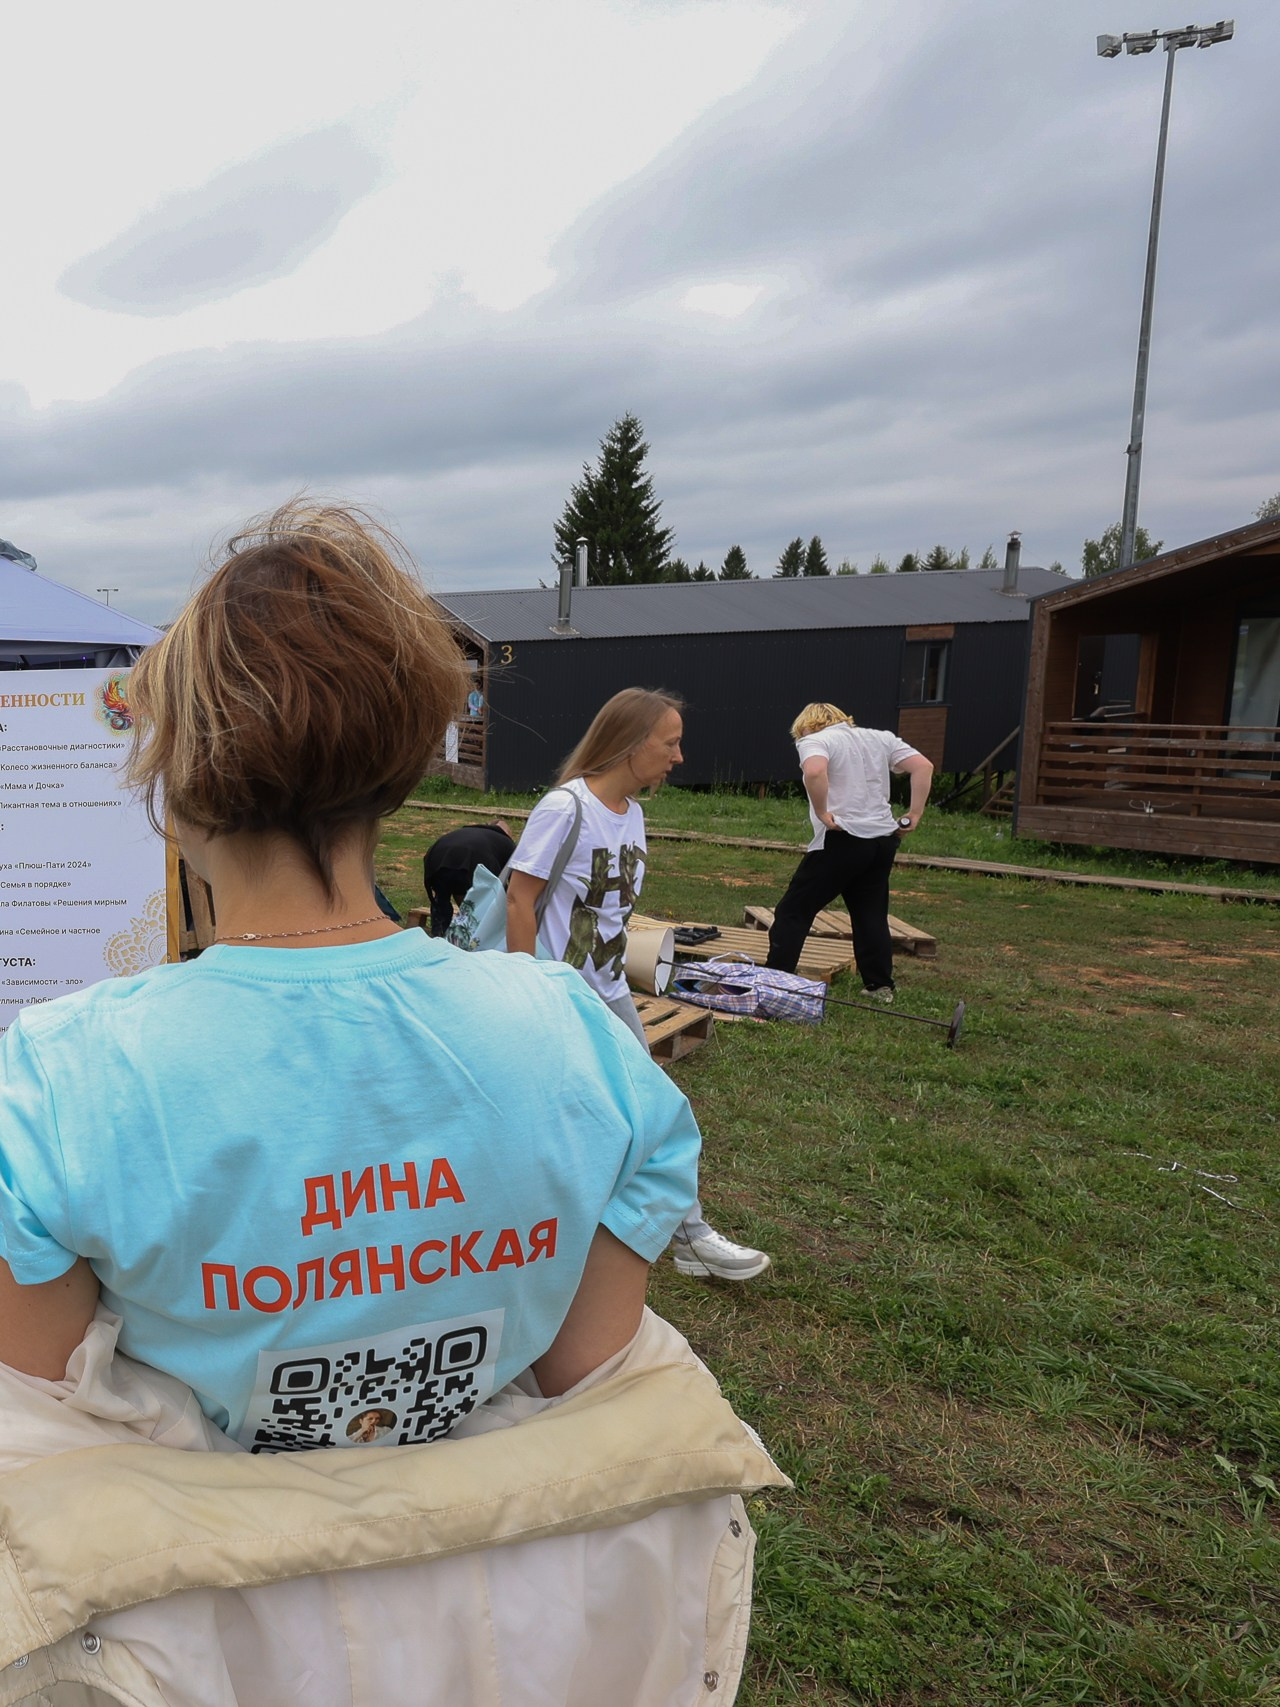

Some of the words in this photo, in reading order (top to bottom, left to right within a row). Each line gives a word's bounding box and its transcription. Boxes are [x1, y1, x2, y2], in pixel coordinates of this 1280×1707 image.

[501, 645, 513, 664] 3
[31, 763, 79, 771] жизненного
[94, 899, 127, 907] мирным
[301, 1157, 466, 1237] ДИНА
[201, 1217, 559, 1314] ПОЛЯНСКАЯ
